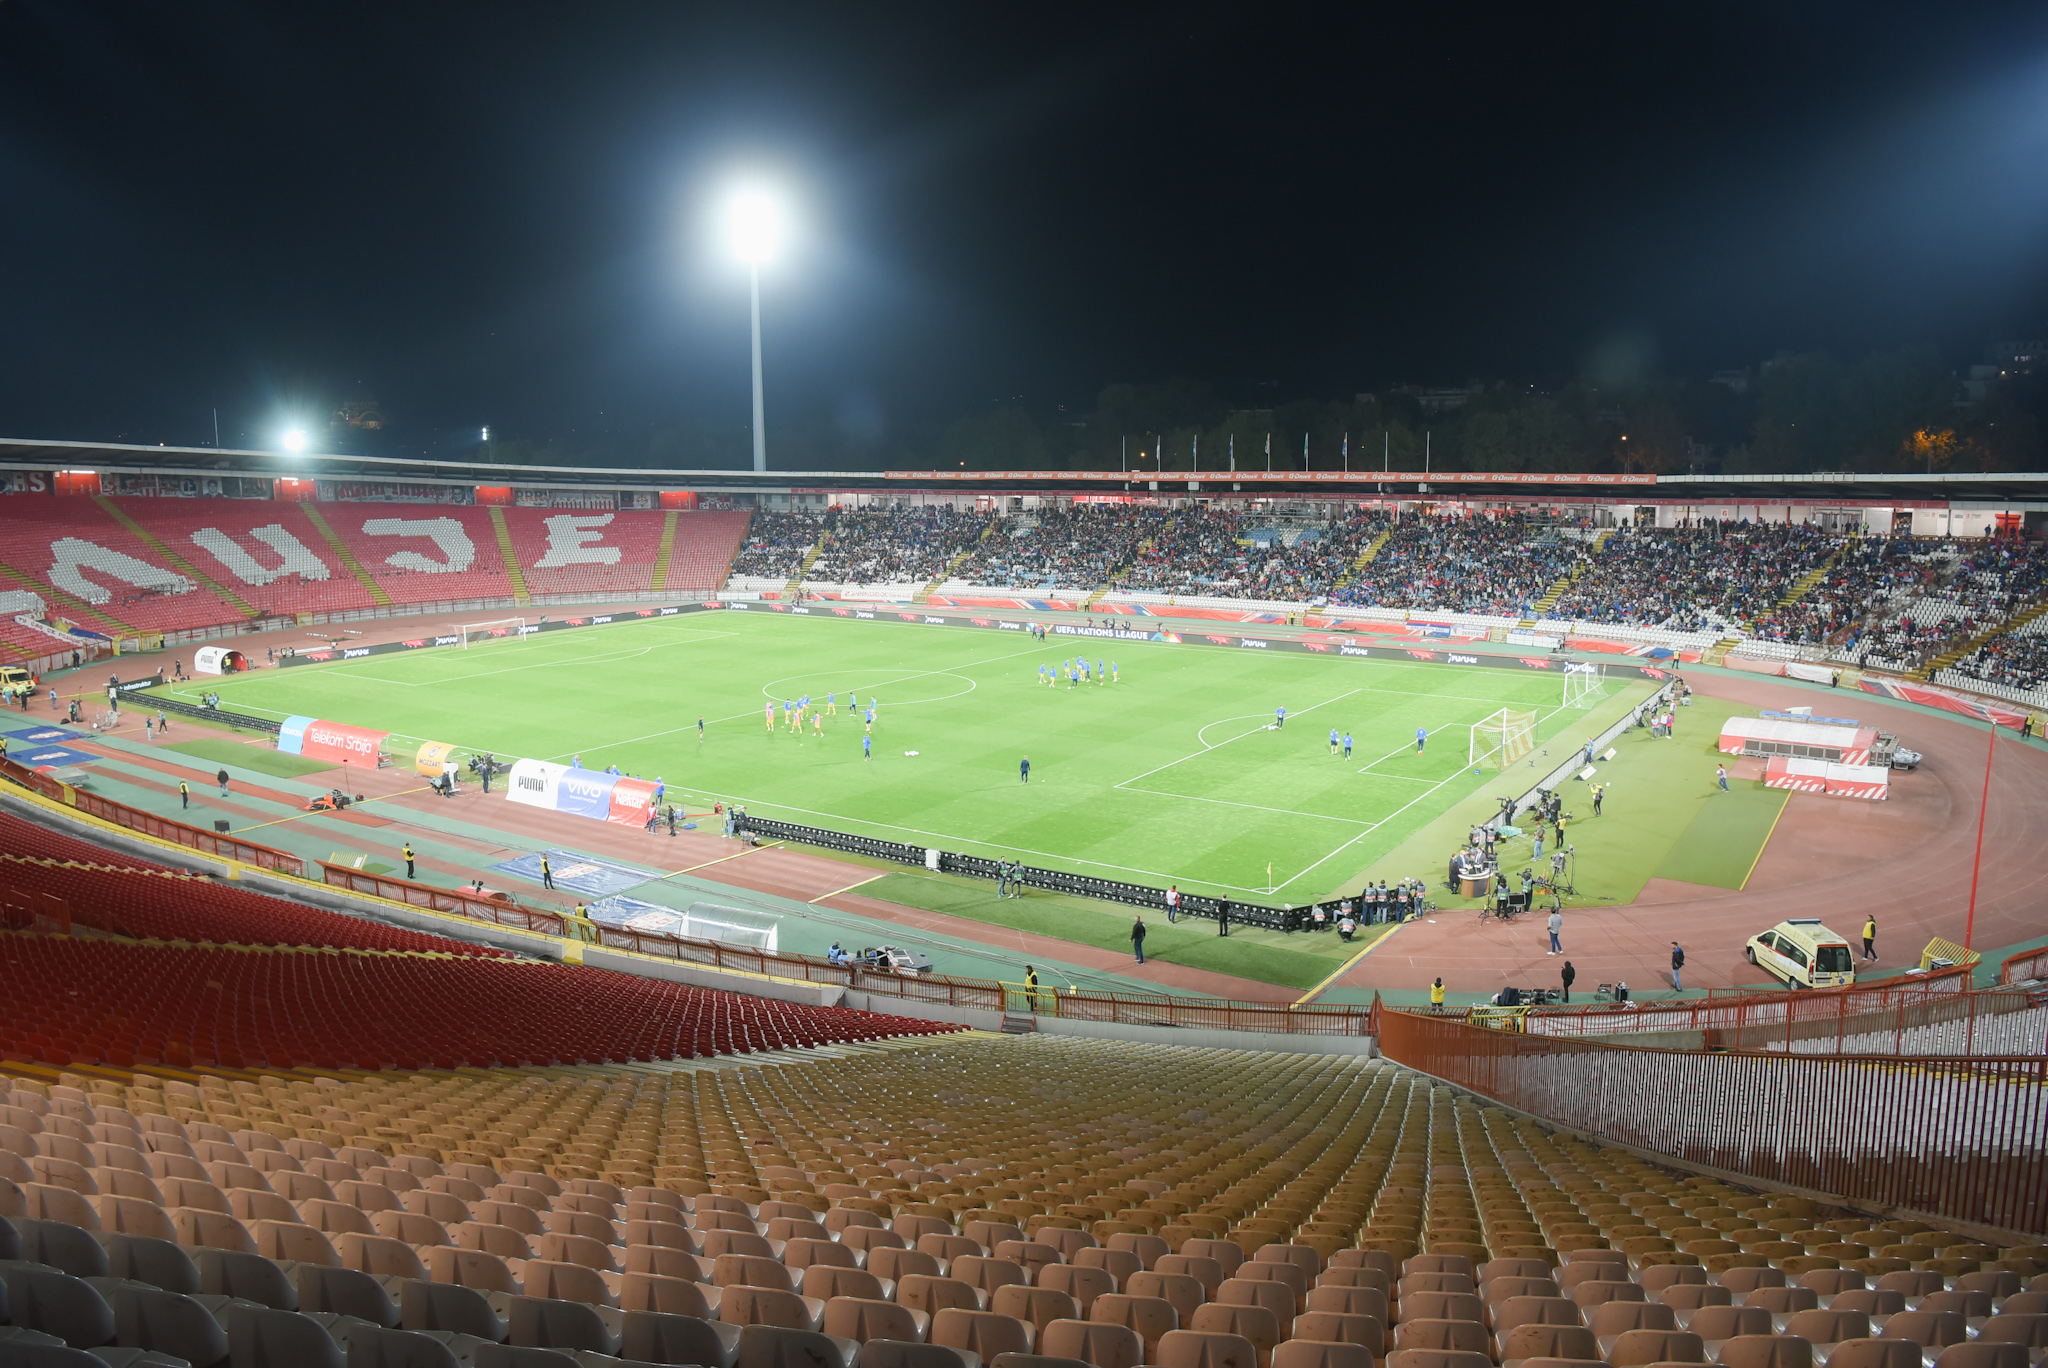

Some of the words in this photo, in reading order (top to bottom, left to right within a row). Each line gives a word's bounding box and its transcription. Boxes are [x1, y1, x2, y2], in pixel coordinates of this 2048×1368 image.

[1056, 625, 1076, 635] UEFA
[1077, 627, 1113, 637] NATIONS
[1115, 630, 1148, 640] LEAGUE
[310, 728, 344, 748] Telekom
[345, 735, 372, 756] Srbija
[419, 758, 441, 768] MOZZART
[518, 775, 544, 792] PUMA
[568, 782, 601, 798] VIVO
[615, 792, 645, 809] Nektar
